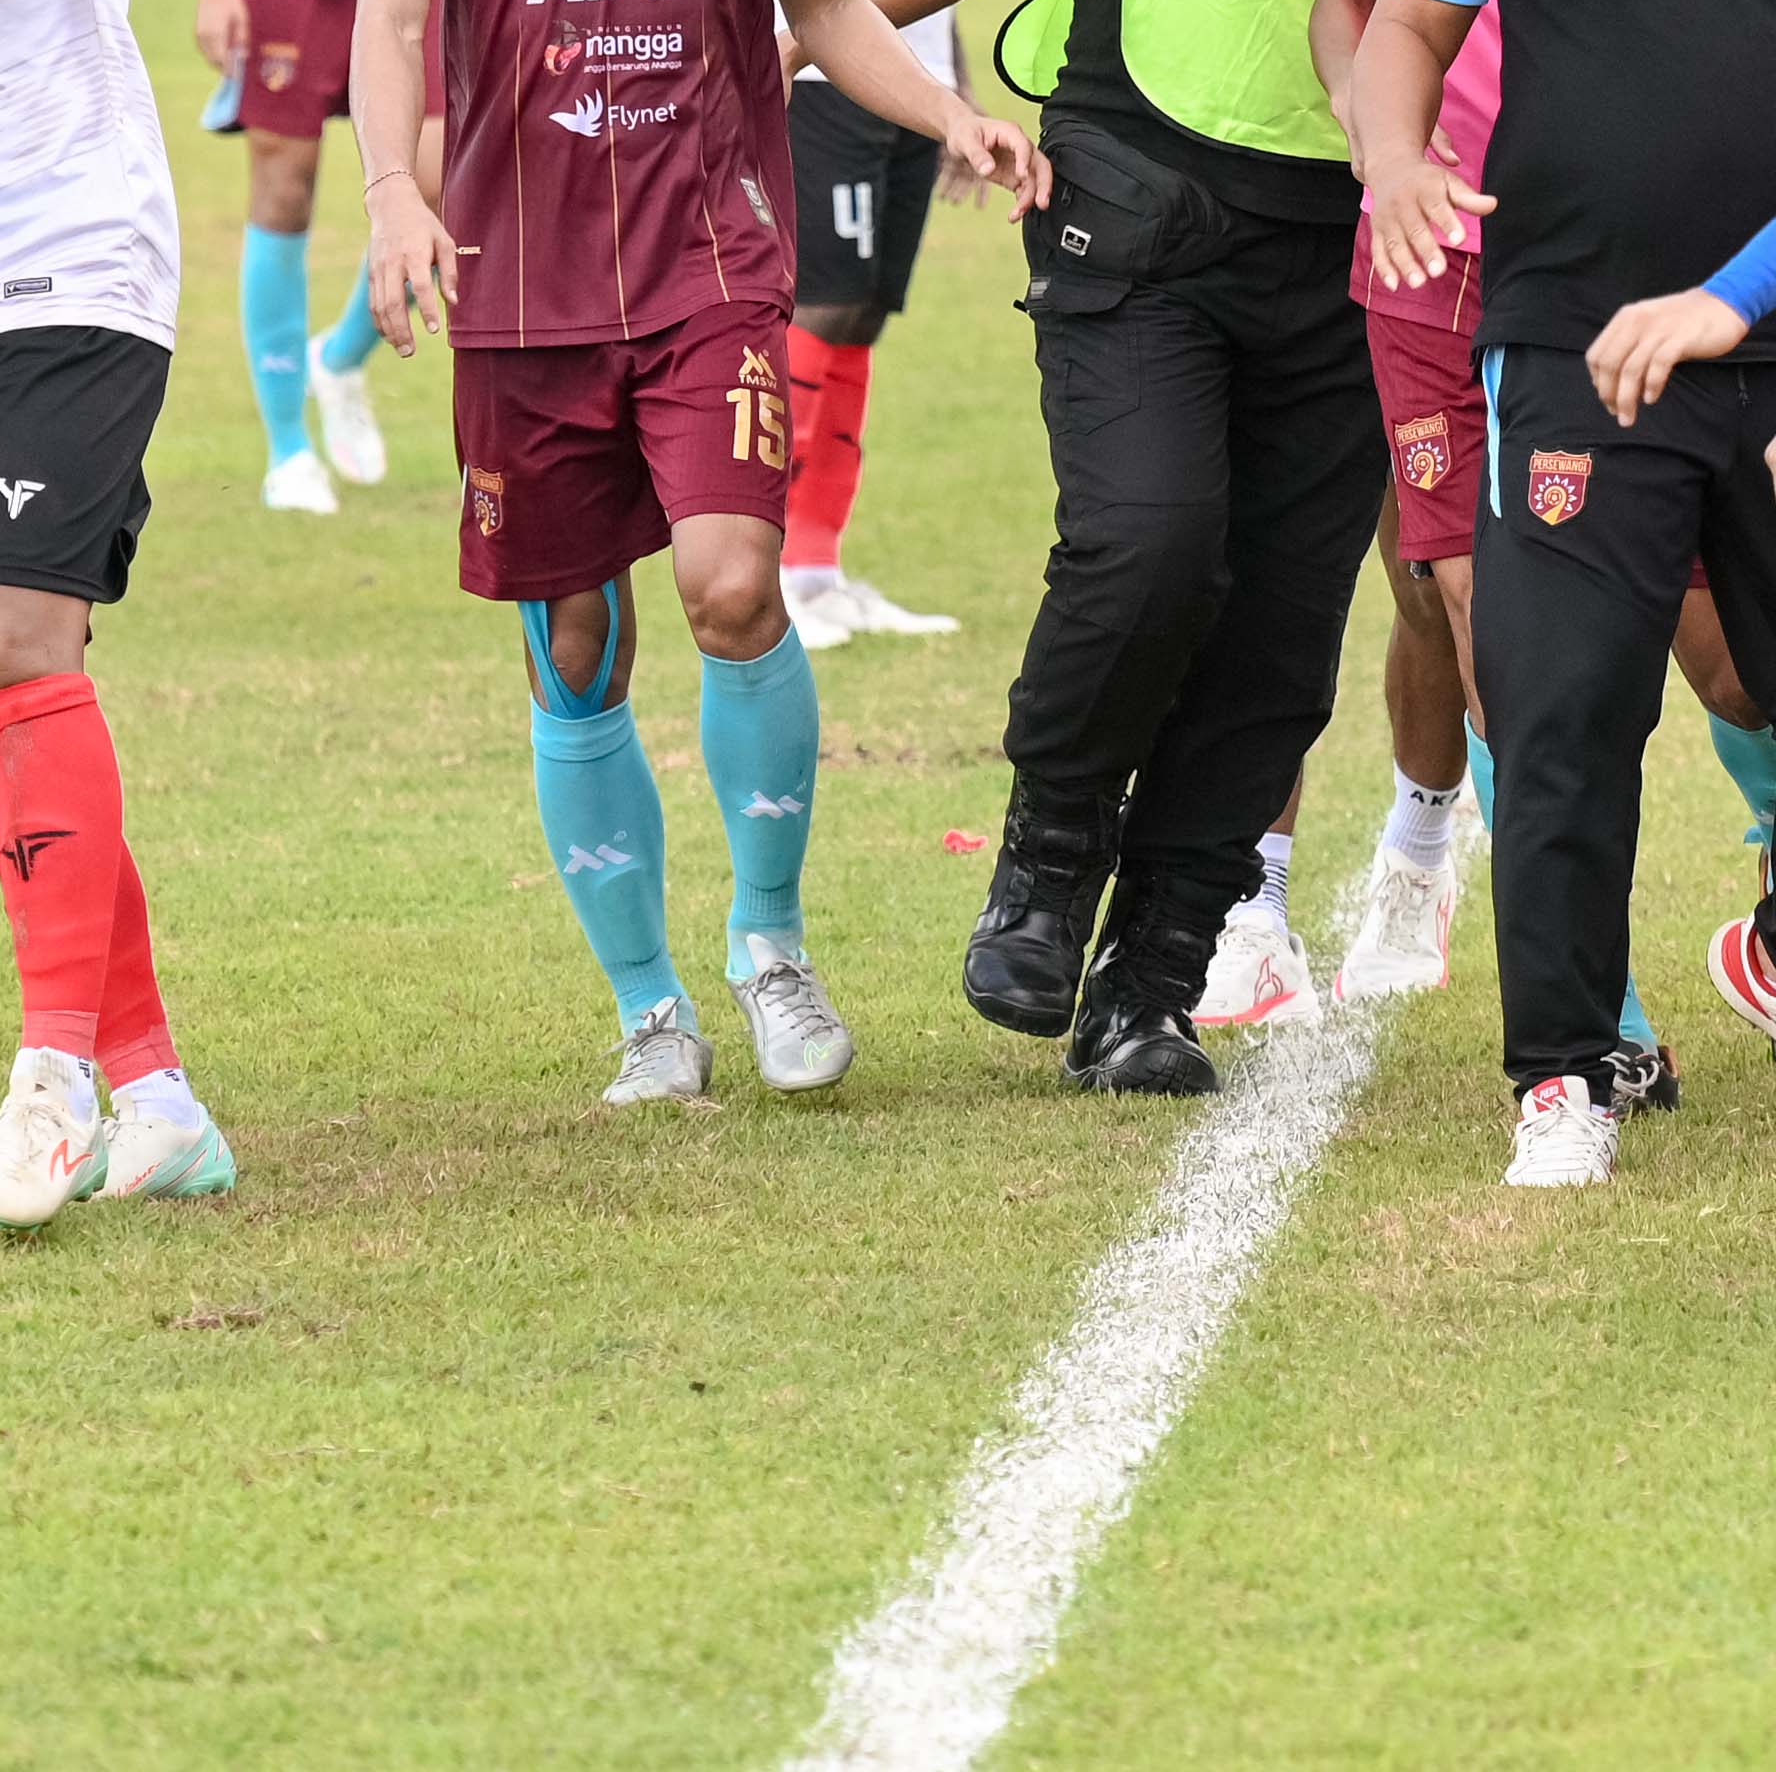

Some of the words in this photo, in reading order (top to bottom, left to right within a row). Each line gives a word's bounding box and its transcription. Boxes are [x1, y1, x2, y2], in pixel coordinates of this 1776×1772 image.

[607, 102, 678, 130] Flynet
[831, 181, 875, 260] 4
[738, 375, 777, 389] TMSW
[725, 387, 786, 471] 15
[1397, 419, 1445, 441] PERSEWANGI
[1532, 458, 1588, 472] PERSEWANGI
